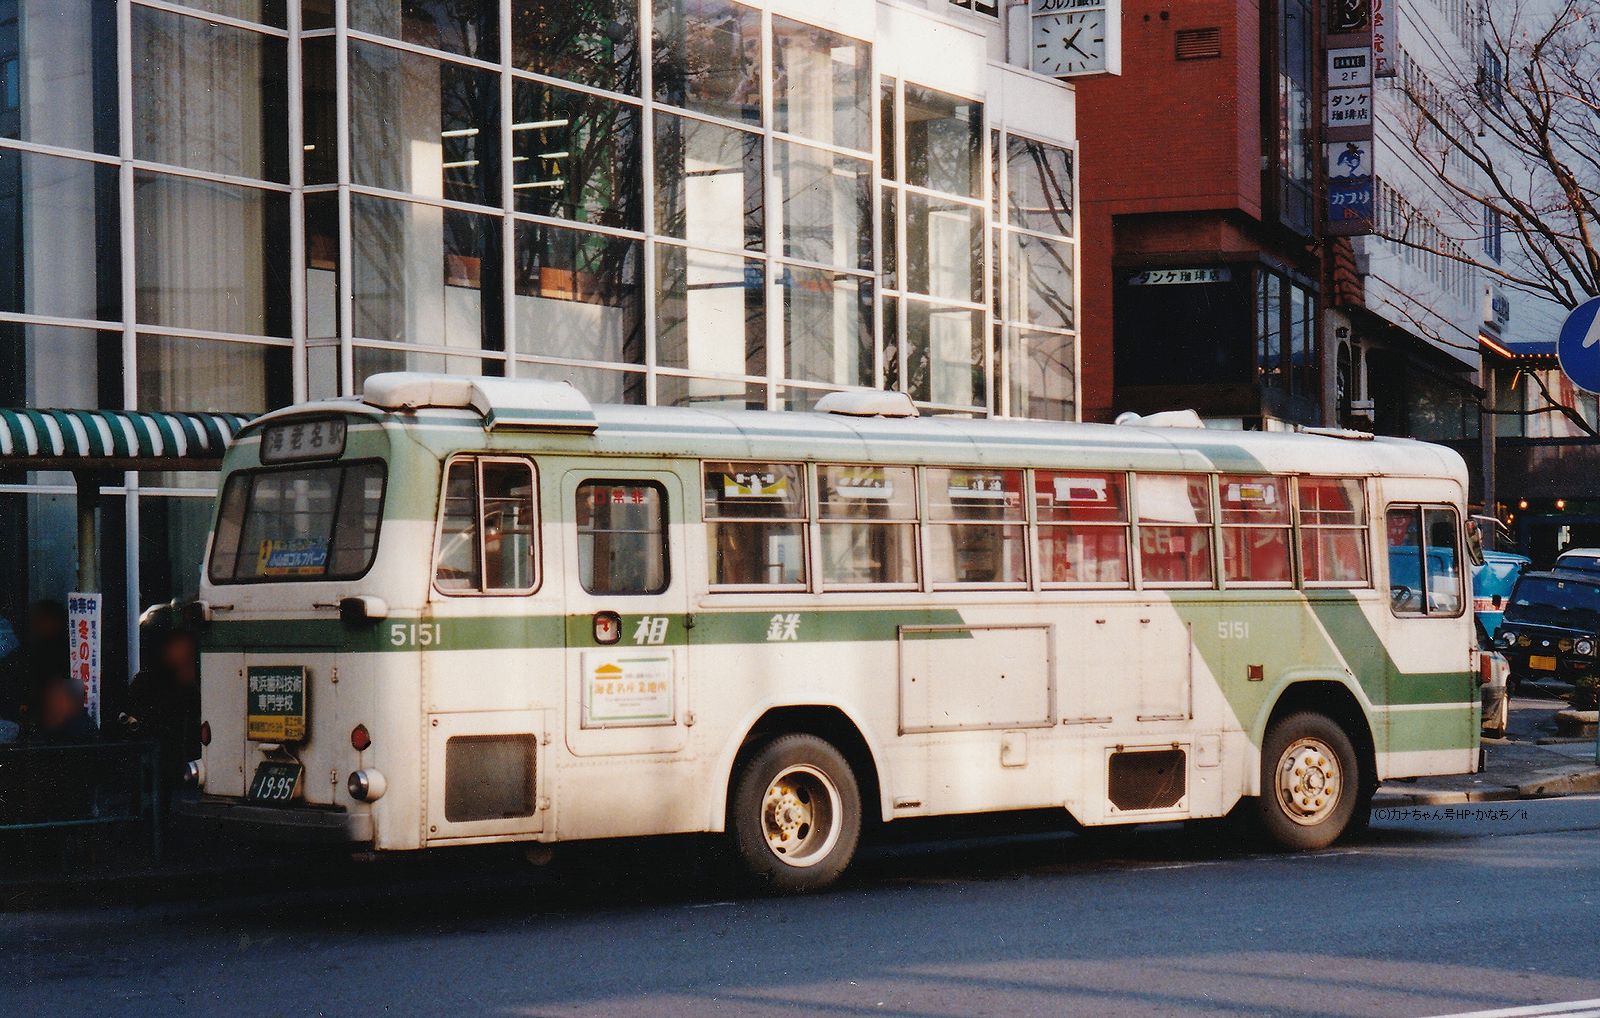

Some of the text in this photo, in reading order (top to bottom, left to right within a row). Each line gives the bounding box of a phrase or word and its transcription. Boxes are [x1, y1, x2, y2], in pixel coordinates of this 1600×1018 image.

[1331, 94, 1368, 106] ダンケ
[1331, 108, 1368, 120] 珈琲店
[391, 624, 440, 646] 5151
[1218, 621, 1249, 639] 5151
[258, 694, 294, 712] 専門学校
